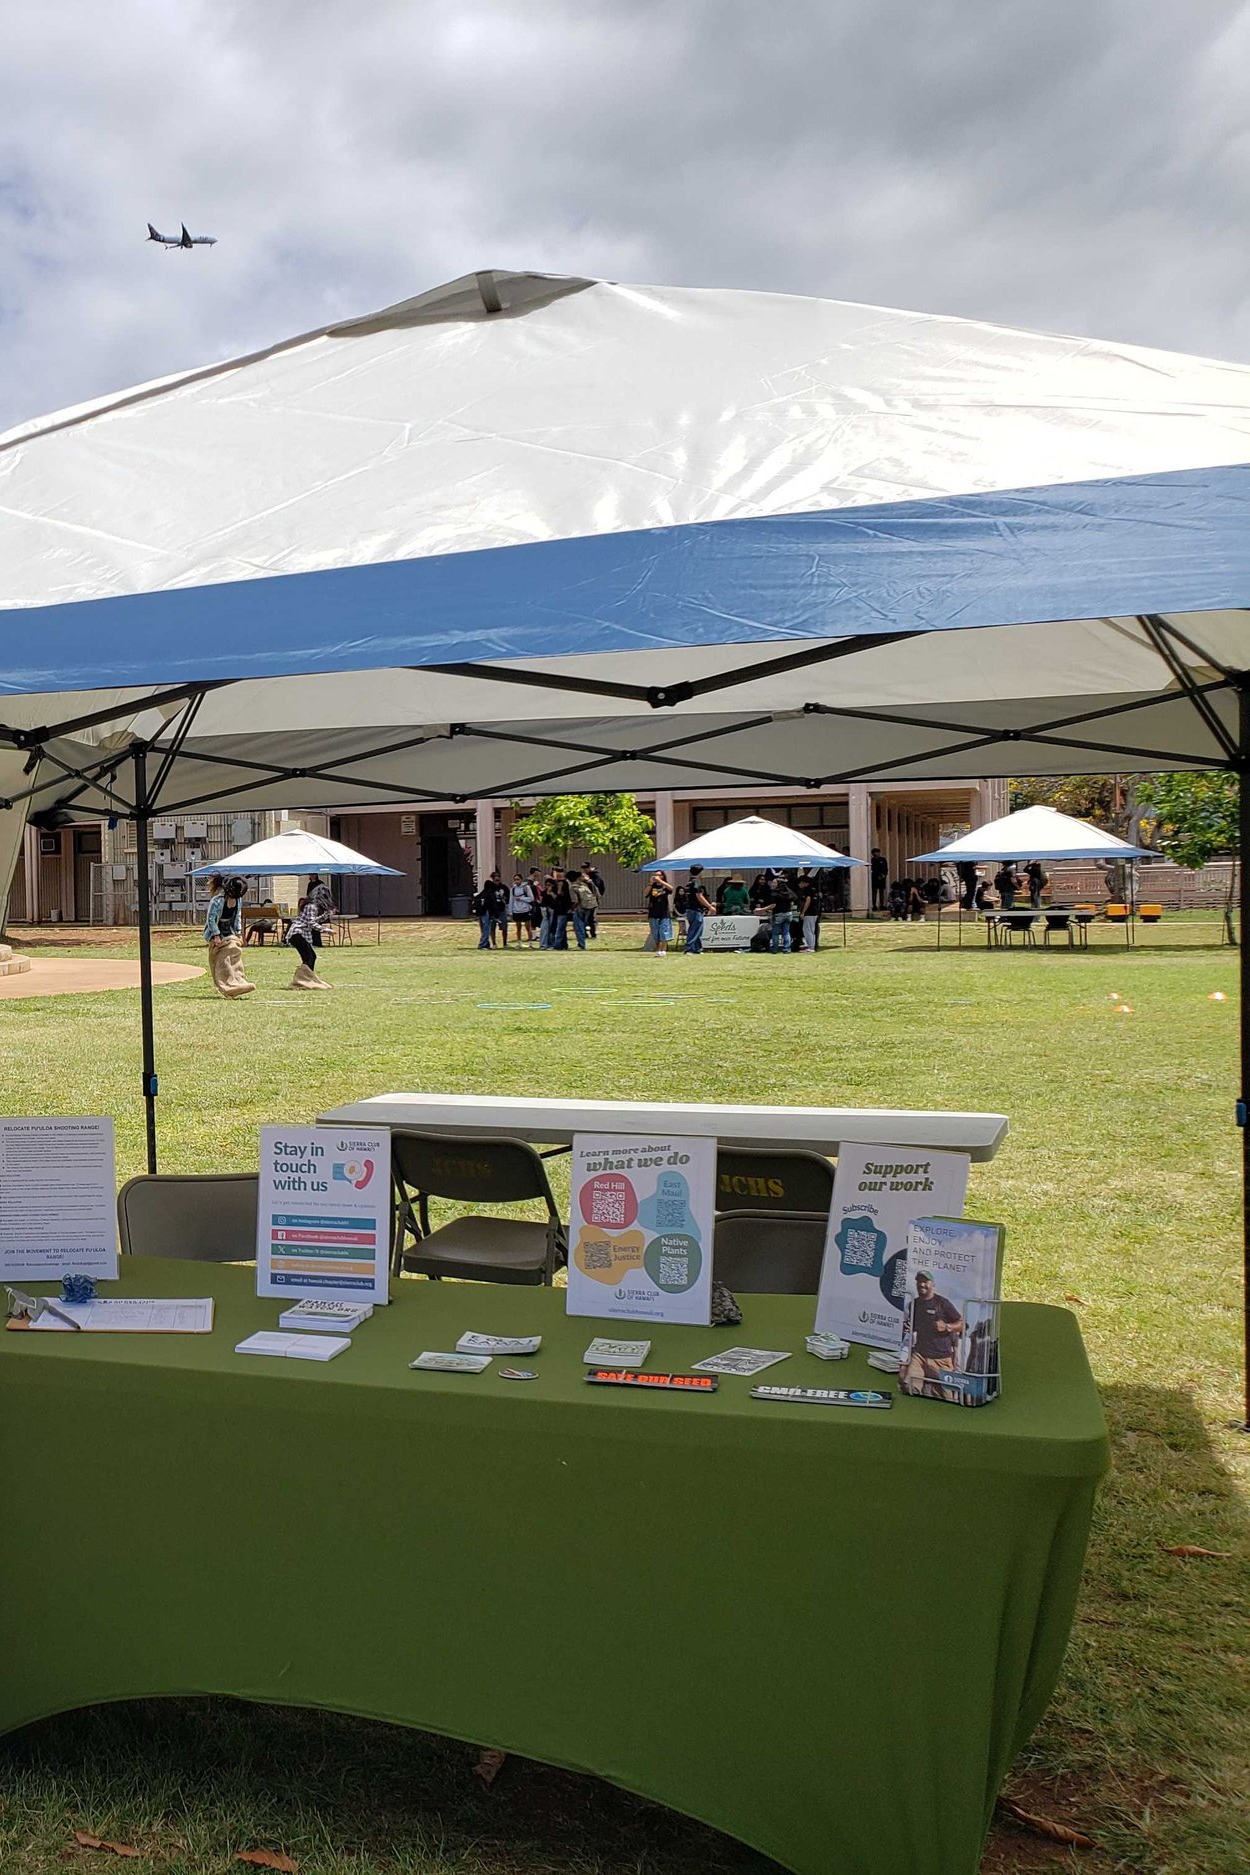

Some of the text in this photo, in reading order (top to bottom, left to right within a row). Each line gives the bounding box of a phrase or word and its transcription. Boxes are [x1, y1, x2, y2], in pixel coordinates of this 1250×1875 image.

[273, 1141, 324, 1159] Stay in
[579, 1144, 672, 1158] Learn more about
[273, 1159, 317, 1174] touch
[586, 1152, 691, 1172] what we do
[862, 1161, 931, 1178] Support
[273, 1176, 328, 1192] with us
[593, 1181, 625, 1190] Red Hill
[663, 1180, 681, 1189] East
[719, 1173, 786, 1198] JCHS
[858, 1177, 934, 1192] our work
[661, 1188, 683, 1197] Maui
[842, 1203, 879, 1216] Subscribe
[661, 1237, 689, 1247] Native
[612, 1245, 640, 1254] Energy
[661, 1246, 688, 1255] Plants
[912, 1246, 976, 1263] AND PROTECT
[613, 1253, 641, 1262] Justice
[911, 1257, 967, 1273] THE PLANET
